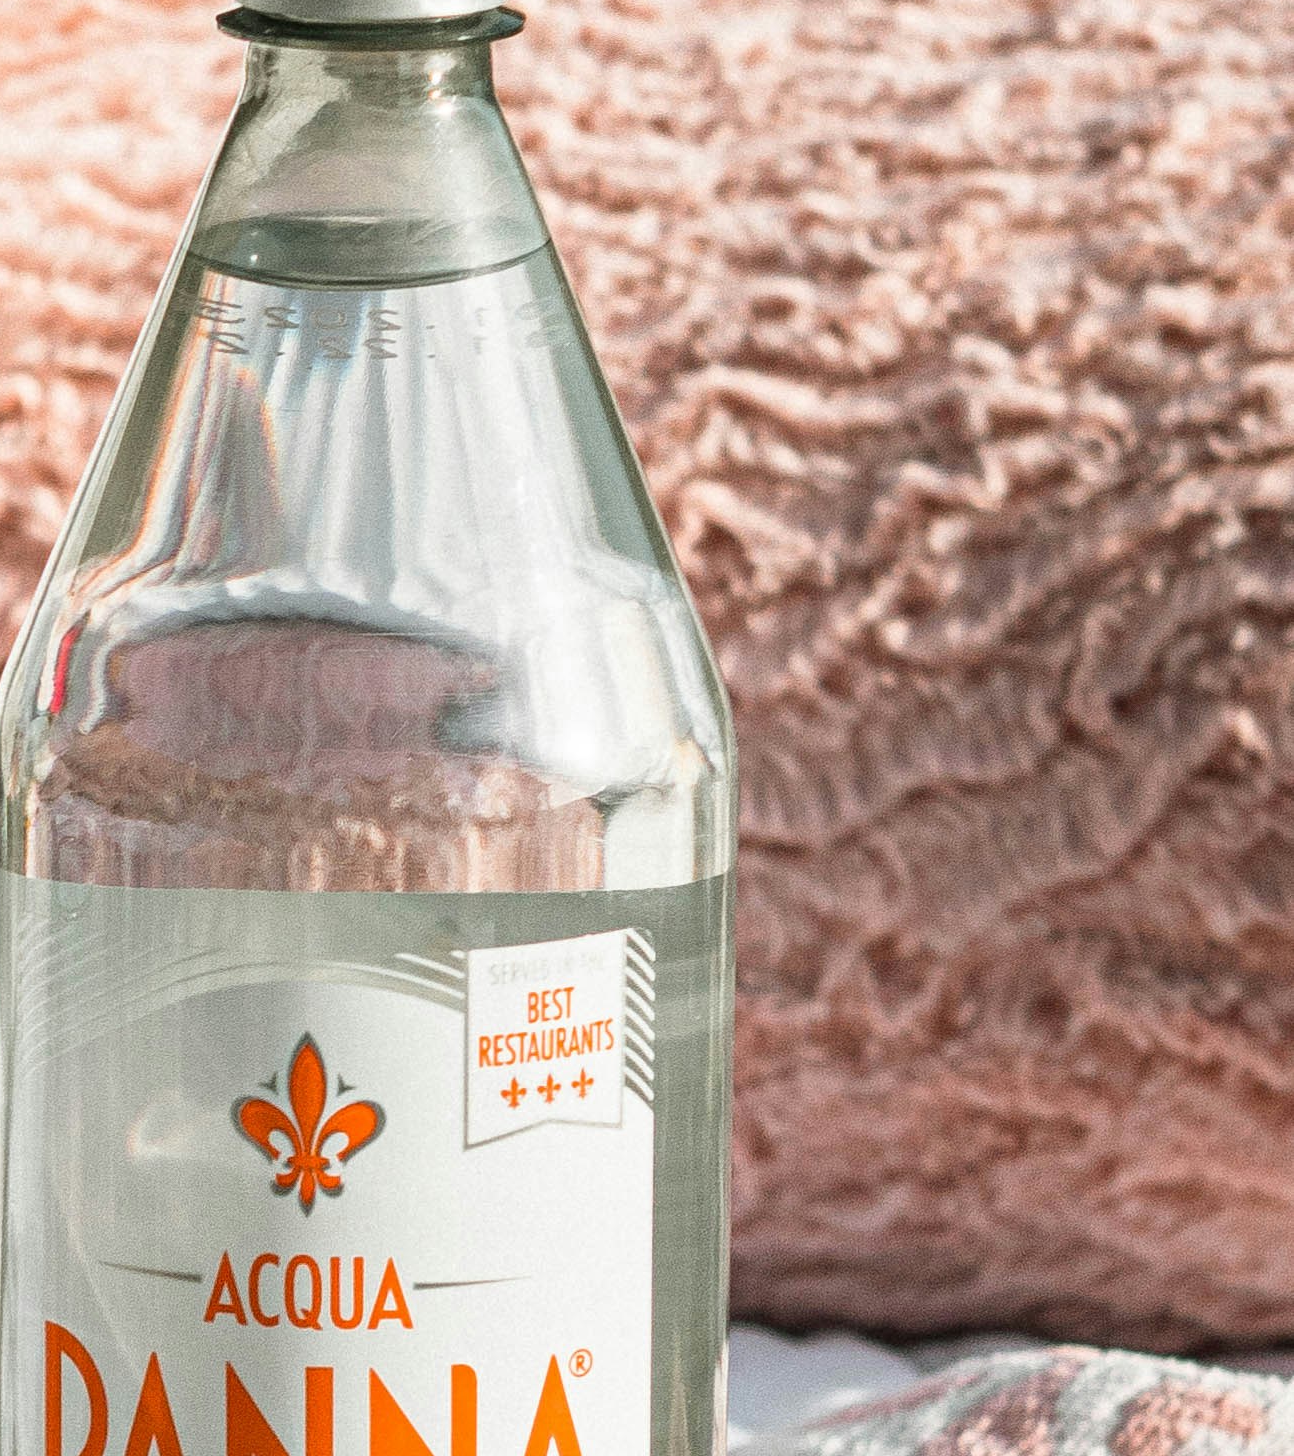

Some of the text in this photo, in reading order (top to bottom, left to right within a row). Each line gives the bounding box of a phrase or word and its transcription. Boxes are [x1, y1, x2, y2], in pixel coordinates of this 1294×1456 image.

[527, 986, 575, 1023] BEST
[478, 1018, 615, 1067] RESTAURANTS
[203, 1249, 414, 1330] ACQUA
